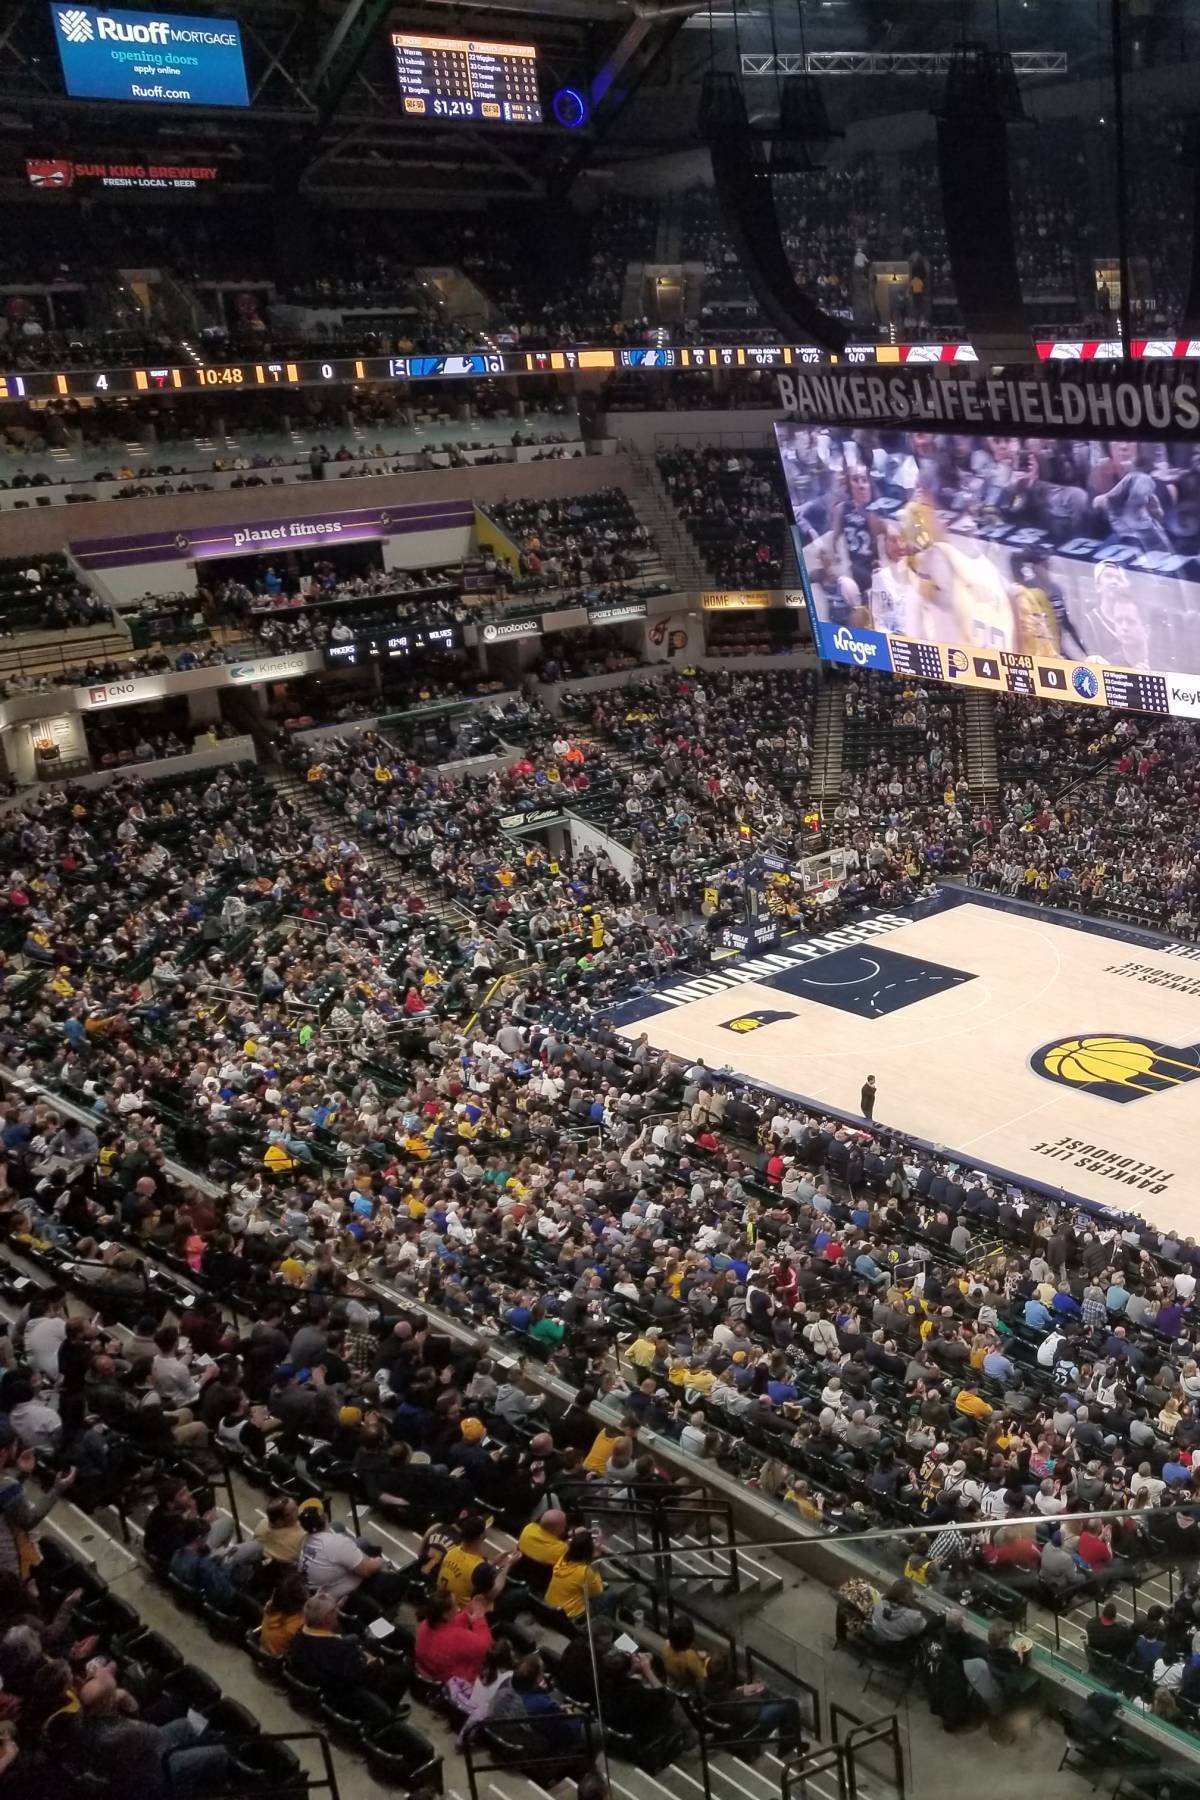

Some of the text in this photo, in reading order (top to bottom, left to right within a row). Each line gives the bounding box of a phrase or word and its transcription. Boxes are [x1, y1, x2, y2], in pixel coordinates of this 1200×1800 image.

[96, 16, 238, 46] Ruoff MORTGAGE
[111, 49, 199, 66] opening doors
[133, 65, 181, 76] apply online
[131, 84, 191, 100] Ruoff.com
[434, 100, 474, 116] $1,219
[75, 163, 217, 180] SUN KING BREWERY
[103, 178, 196, 188] FRESH LOCAL BEER
[696, 356, 703, 365] 0
[724, 355, 731, 364] 0
[756, 355, 774, 364] 0/3
[802, 354, 820, 364] 0/2
[848, 353, 866, 362] 0/0
[197, 368, 243, 385] 10:48
[322, 364, 333, 379] 0
[96, 374, 108, 391] 4
[777, 373, 914, 420] BANKERS
[916, 380, 986, 422] LIFE
[234, 520, 342, 547] planet fitness
[704, 595, 728, 608] HOME
[589, 604, 646, 620] SPORT GRAPHICS
[498, 621, 537, 635] motorola
[388, 637, 407, 648] 10:48
[832, 627, 878, 665] Kroger
[259, 658, 305, 674] Kinetico
[1002, 654, 1032, 668] 10:48
[982, 662, 991, 676] 4
[1047, 672, 1057, 686] 0
[108, 683, 135, 697] CNO
[754, 924, 776, 936] BELLE
[757, 932, 775, 943] TIRE
[651, 912, 914, 1006] INDIANA PACERS
[1102, 966, 1137, 978] LIFE
[1054, 1136, 1175, 1182] FIELDHOUSE
[1030, 1142, 1169, 1195] BANKERS LIFE
[1054, 1372, 1068, 1386] 22
